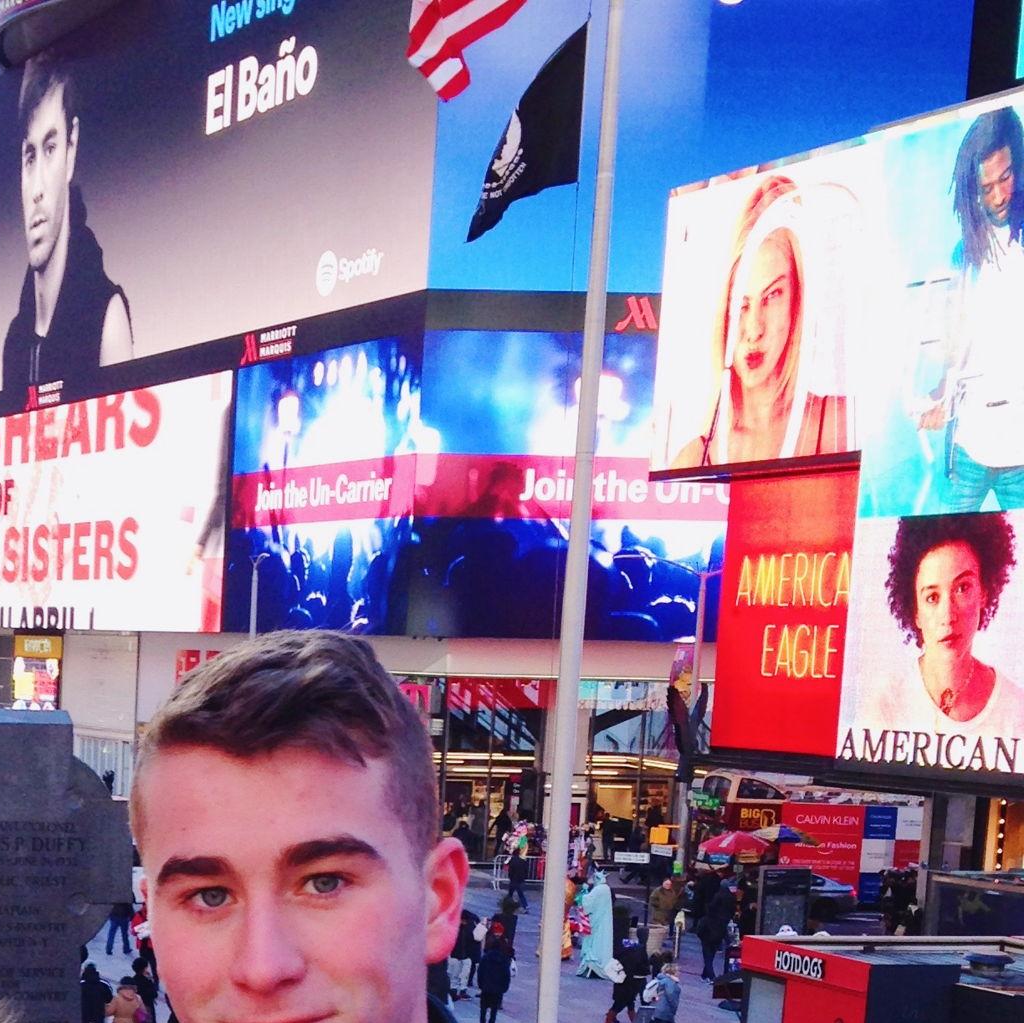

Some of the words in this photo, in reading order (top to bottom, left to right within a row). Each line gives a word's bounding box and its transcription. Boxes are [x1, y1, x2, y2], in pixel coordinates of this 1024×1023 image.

[210, 0, 253, 42] New
[206, 64, 233, 135] El
[237, 36, 318, 122] Baño
[337, 248, 384, 283] Spotify
[259, 340, 292, 357] MARQUIS
[260, 325, 297, 343] MARRIOTT
[255, 482, 283, 512] Join
[284, 479, 308, 509] the
[309, 470, 393, 507] Un-Carrier
[592, 469, 649, 504] the
[2, 517, 139, 584] SISTERS
[736, 551, 852, 607] AMERICA
[760, 624, 839, 678] EAGLE
[836, 727, 1021, 773] AMERICAN
[740, 807, 761, 819] BIG
[796, 814, 831, 825] CALVIN
[831, 816, 860, 826] KLEIN
[31, 837, 87, 852] DUFFY
[774, 949, 823, 980] HOTDOGS
